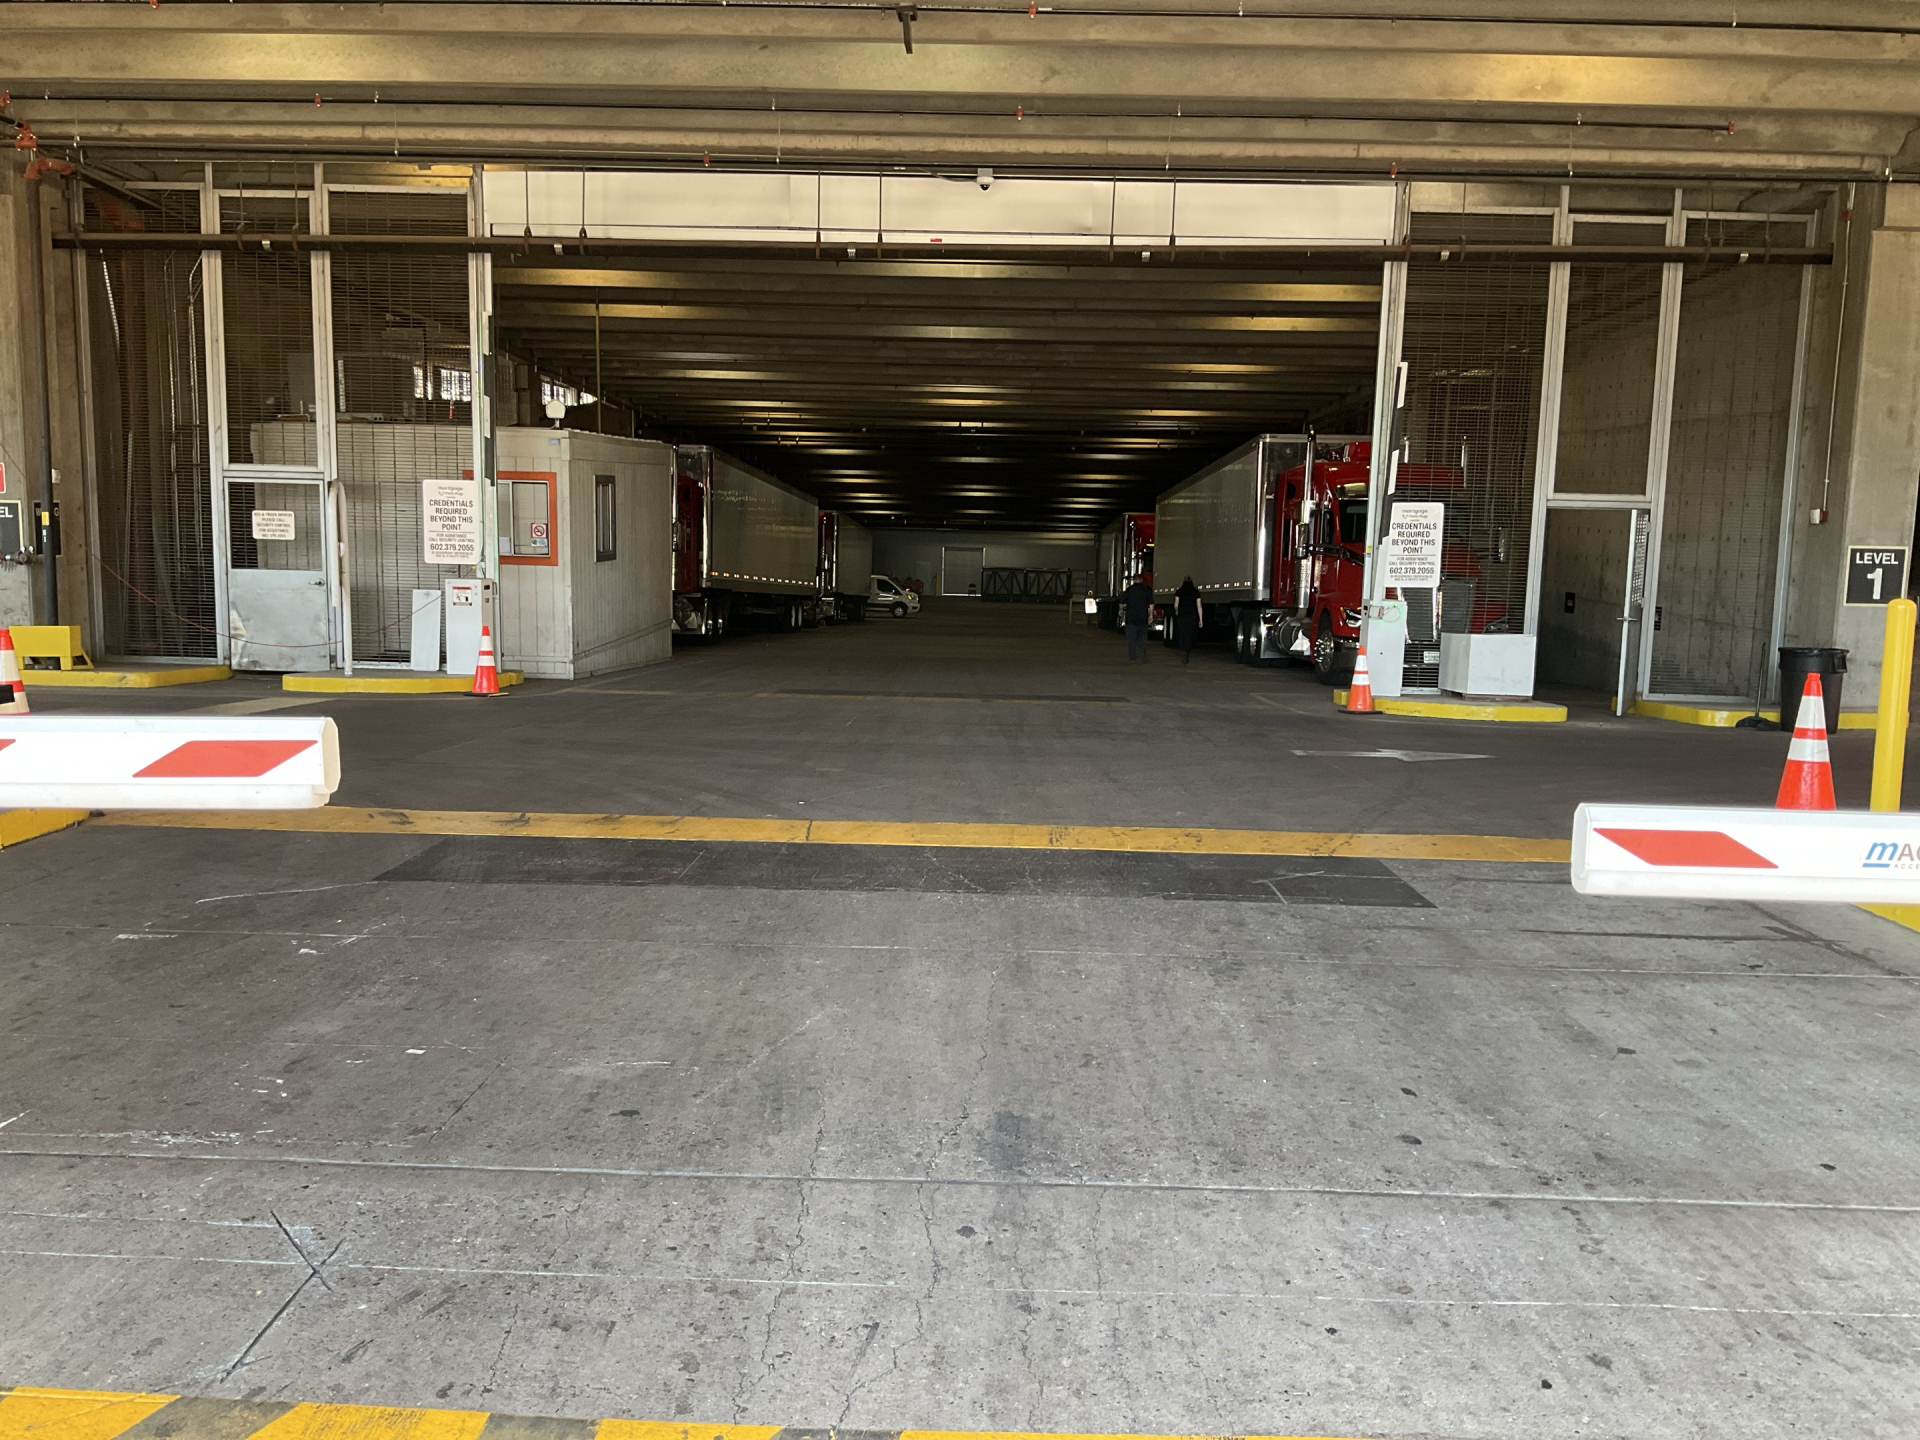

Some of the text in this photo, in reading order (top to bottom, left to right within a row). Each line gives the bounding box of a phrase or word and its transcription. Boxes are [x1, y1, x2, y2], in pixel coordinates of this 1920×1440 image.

[429, 499, 473, 507] CREDENTIALS
[458, 516, 473, 524] THIS
[430, 543, 474, 552] 602.379.2055
[1856, 552, 1899, 564] LEVEL
[1866, 568, 1883, 600] 1
